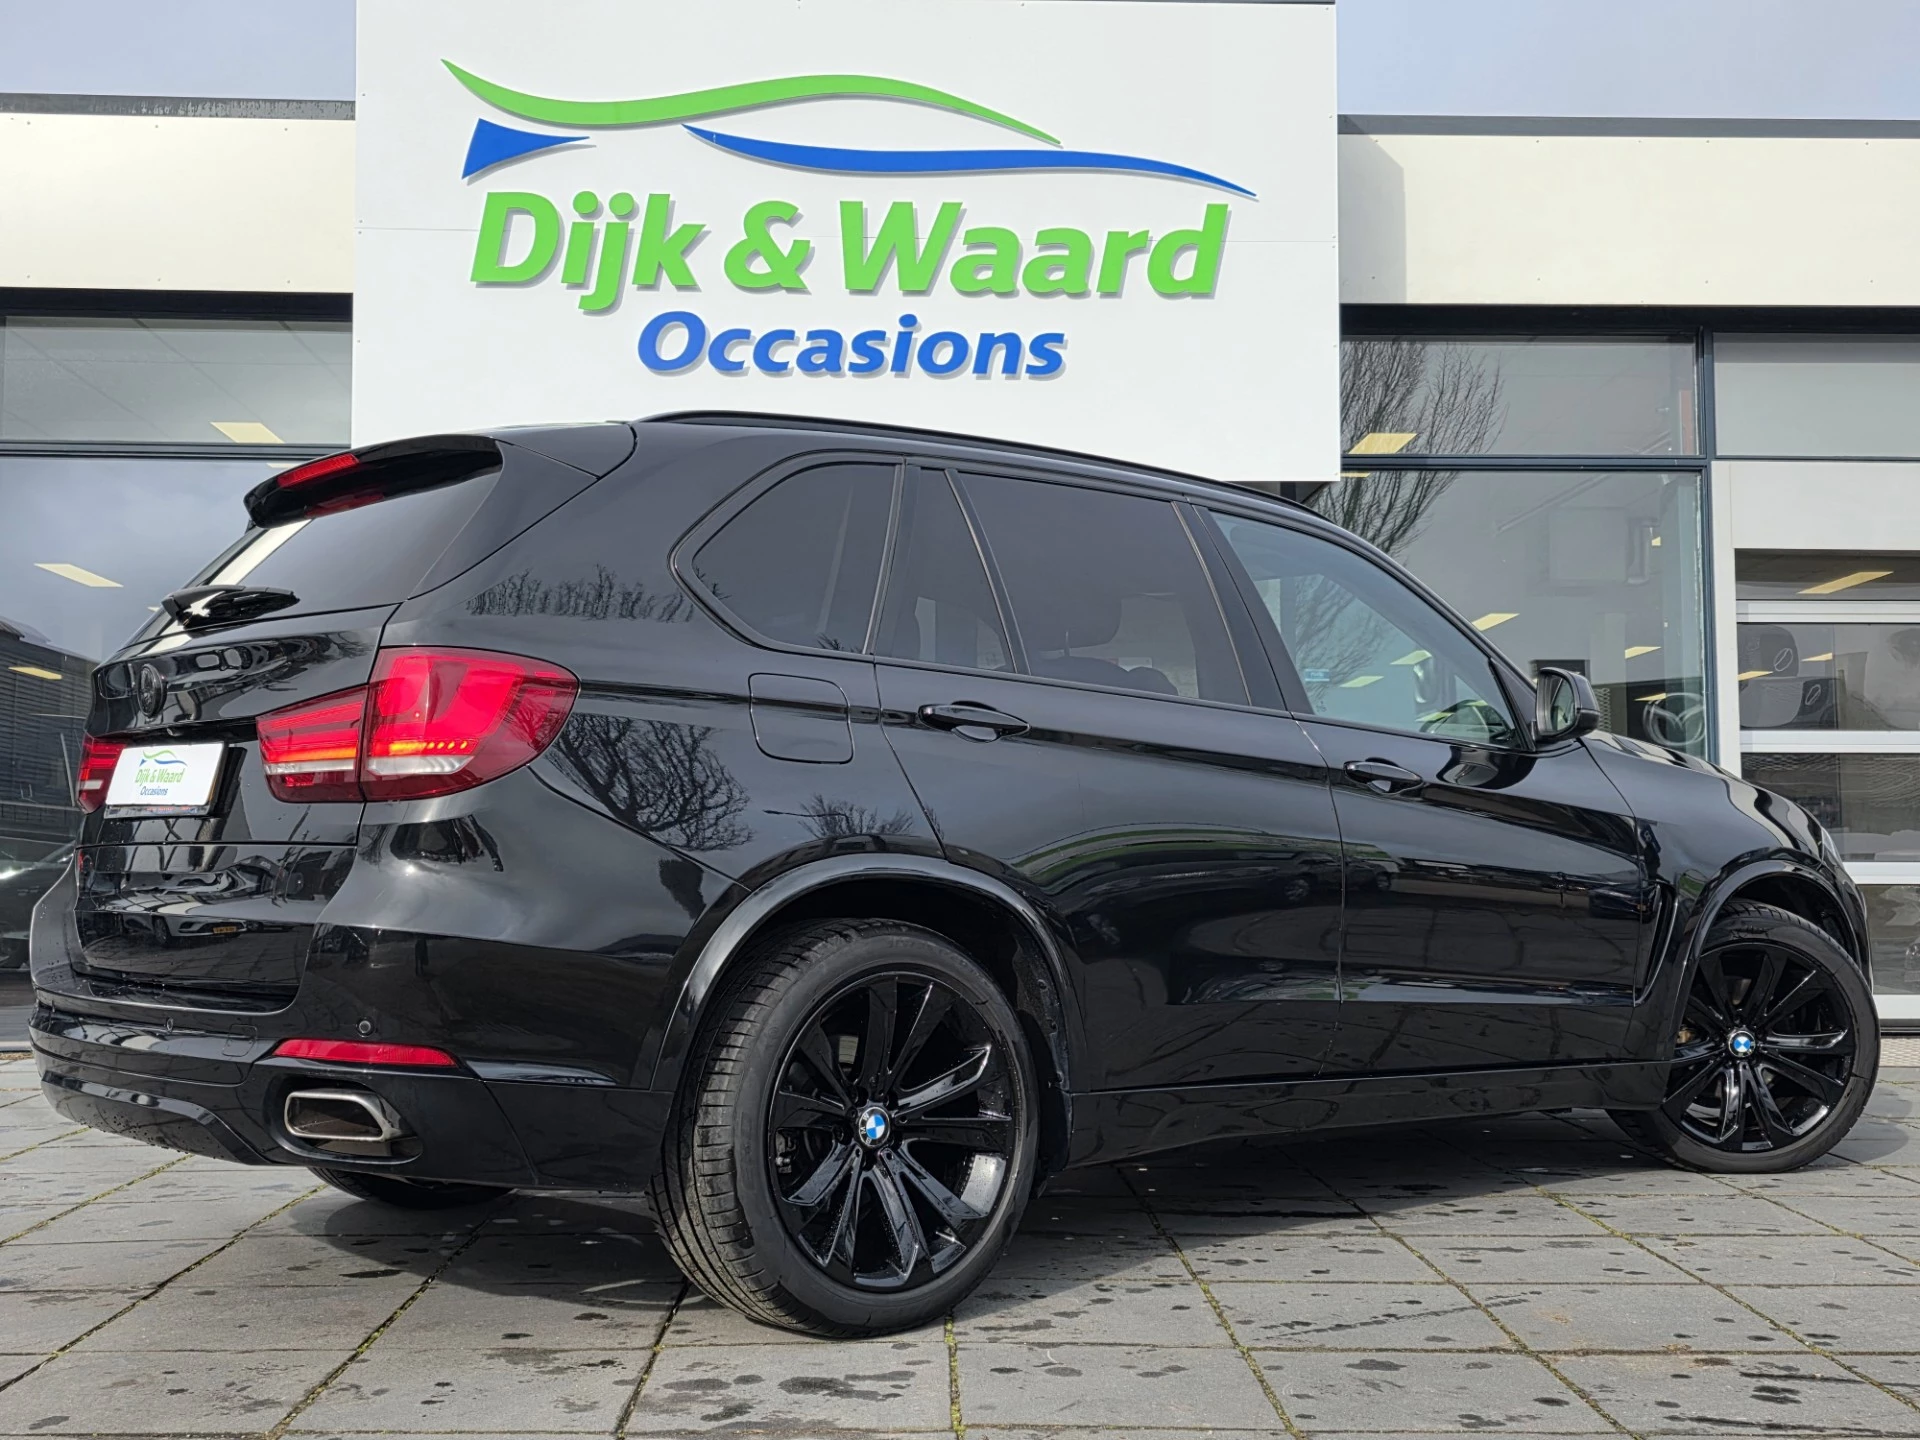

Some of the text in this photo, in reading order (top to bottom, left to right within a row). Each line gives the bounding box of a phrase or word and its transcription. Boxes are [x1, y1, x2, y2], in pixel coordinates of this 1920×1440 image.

[471, 191, 1228, 311] Dijk & Waard
[637, 311, 1065, 376] Occasions
[135, 768, 186, 786] Dijk & Waard
[140, 786, 168, 796] Occasions
